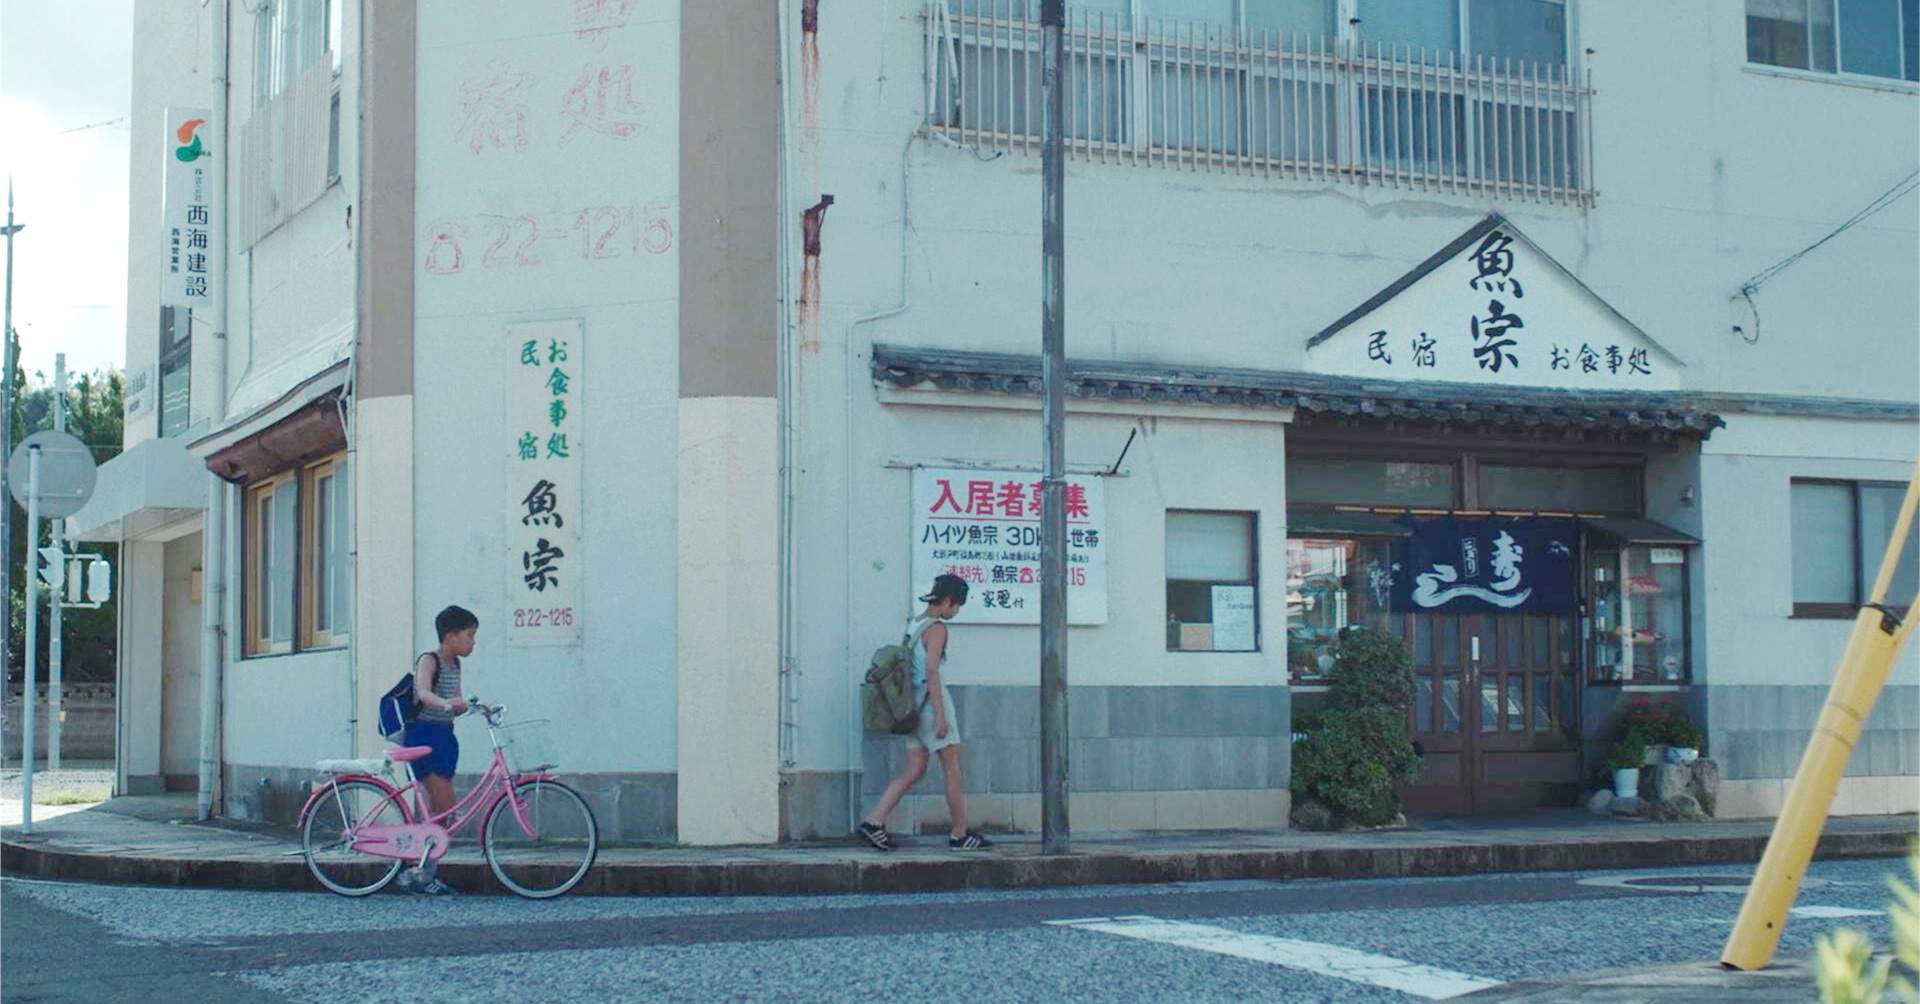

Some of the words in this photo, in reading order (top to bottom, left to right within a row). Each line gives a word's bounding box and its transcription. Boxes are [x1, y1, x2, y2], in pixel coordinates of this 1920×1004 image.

[186, 204, 208, 298] 西海建設
[1468, 230, 1524, 373] 魚宗
[1368, 330, 1437, 368] 民宿
[1550, 342, 1652, 375] お食事処
[518, 340, 541, 461] 民宿
[546, 338, 570, 459] お食事処
[522, 479, 565, 592] 魚宗
[921, 524, 998, 545] ハイツ魚宗
[1067, 529, 1099, 548] 世帯
[992, 565, 1018, 584] 魚宗
[527, 607, 573, 626] 22-1215
